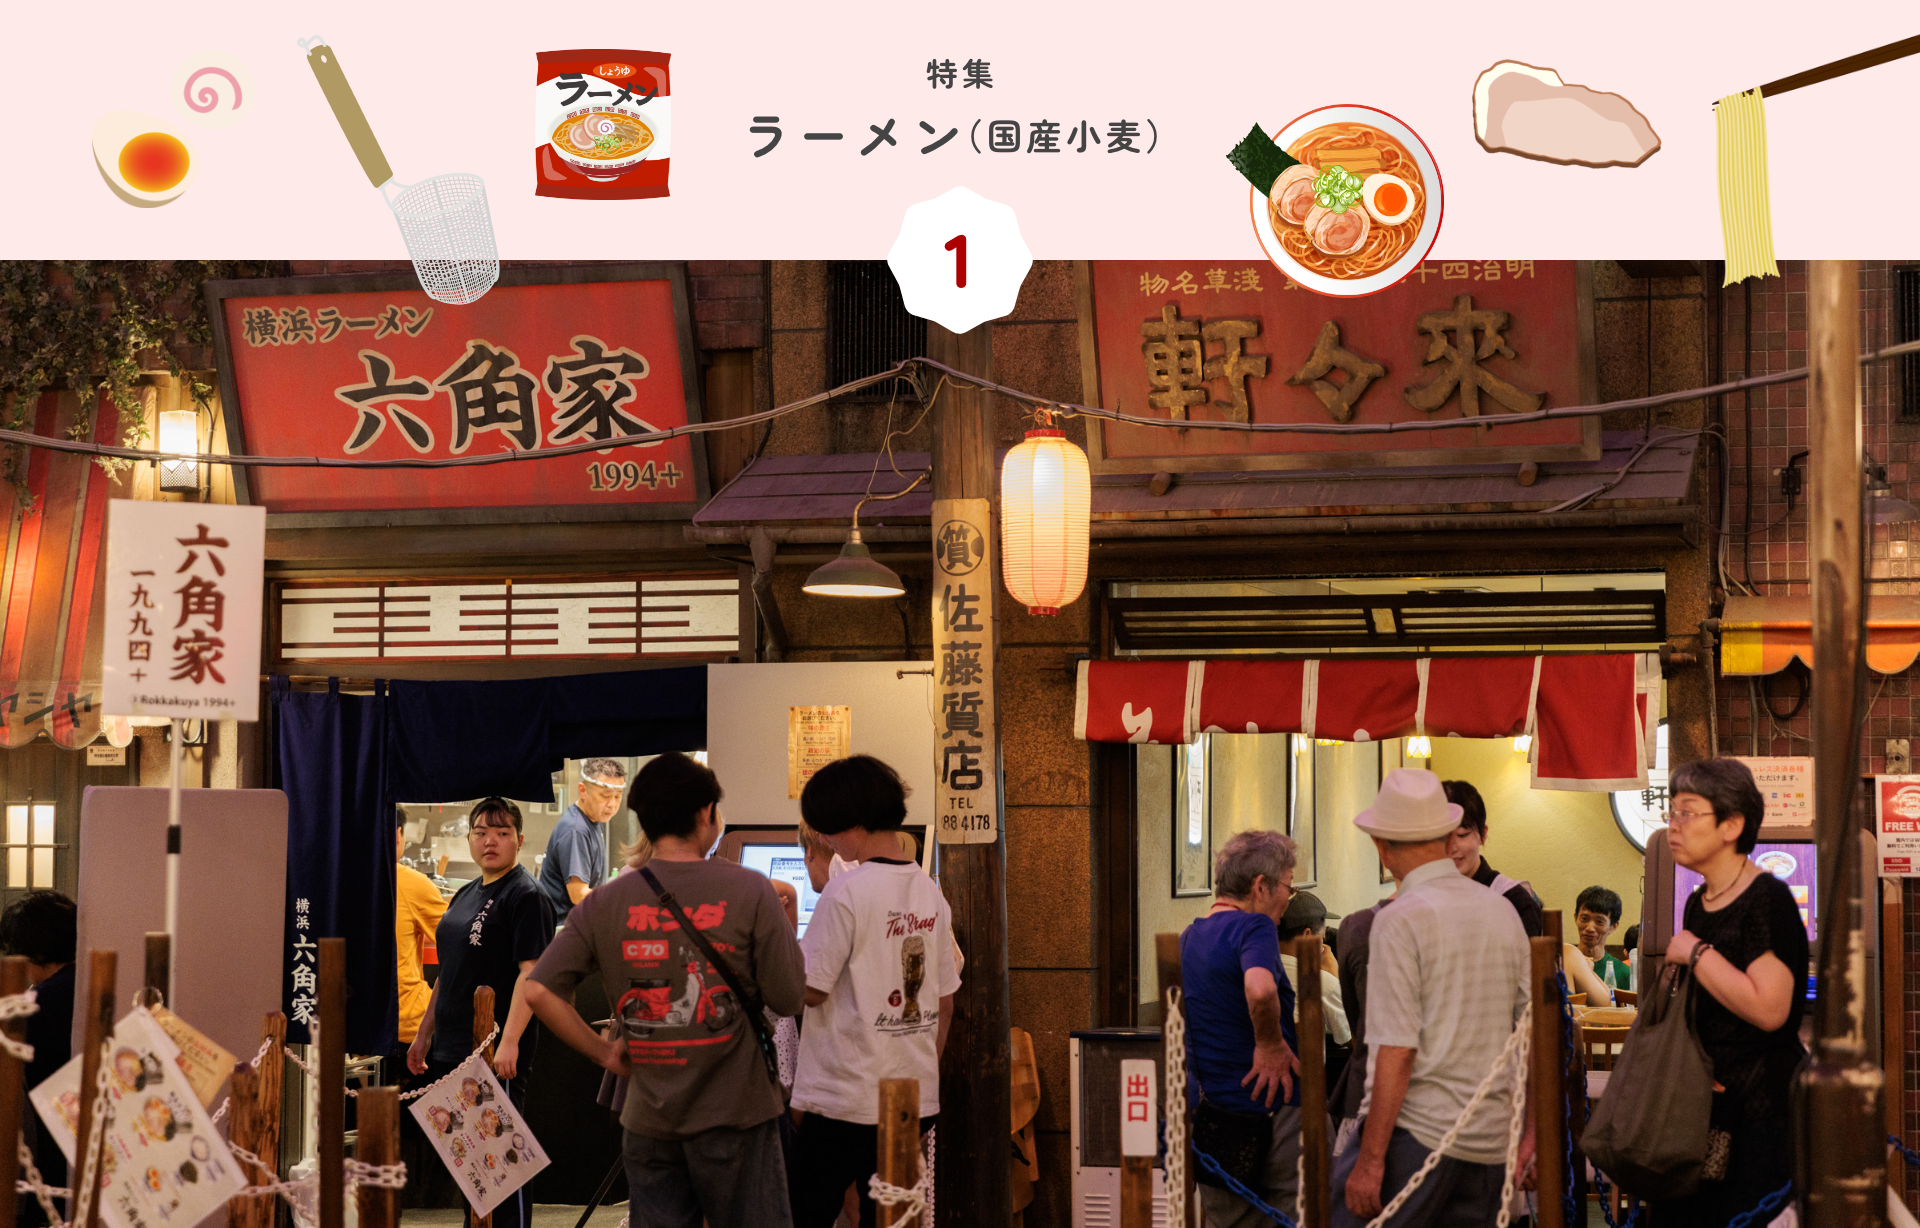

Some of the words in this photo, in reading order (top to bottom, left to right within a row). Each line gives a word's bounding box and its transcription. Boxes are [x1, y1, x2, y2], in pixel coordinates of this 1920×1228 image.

[242, 305, 433, 346] 横浜ラーメン
[335, 334, 664, 454] 六角家
[586, 460, 683, 492] 1994+
[169, 523, 230, 685] 六角家
[141, 695, 200, 709] Rokkakuya
[938, 584, 984, 791] 佐藤質店
[949, 797, 974, 810] TEL
[1641, 785, 1669, 811] 軒
[1885, 821, 1914, 831] FREE
[296, 898, 310, 930] 横浜
[469, 910, 489, 946] 六角家
[626, 900, 728, 932] ホンダ
[886, 916, 905, 939] The
[627, 944, 638, 956] C
[641, 944, 665, 956] 70
[291, 933, 318, 1025] 六角家
[1127, 1074, 1149, 1122] 出口
[467, 1171, 487, 1198] 六角家
